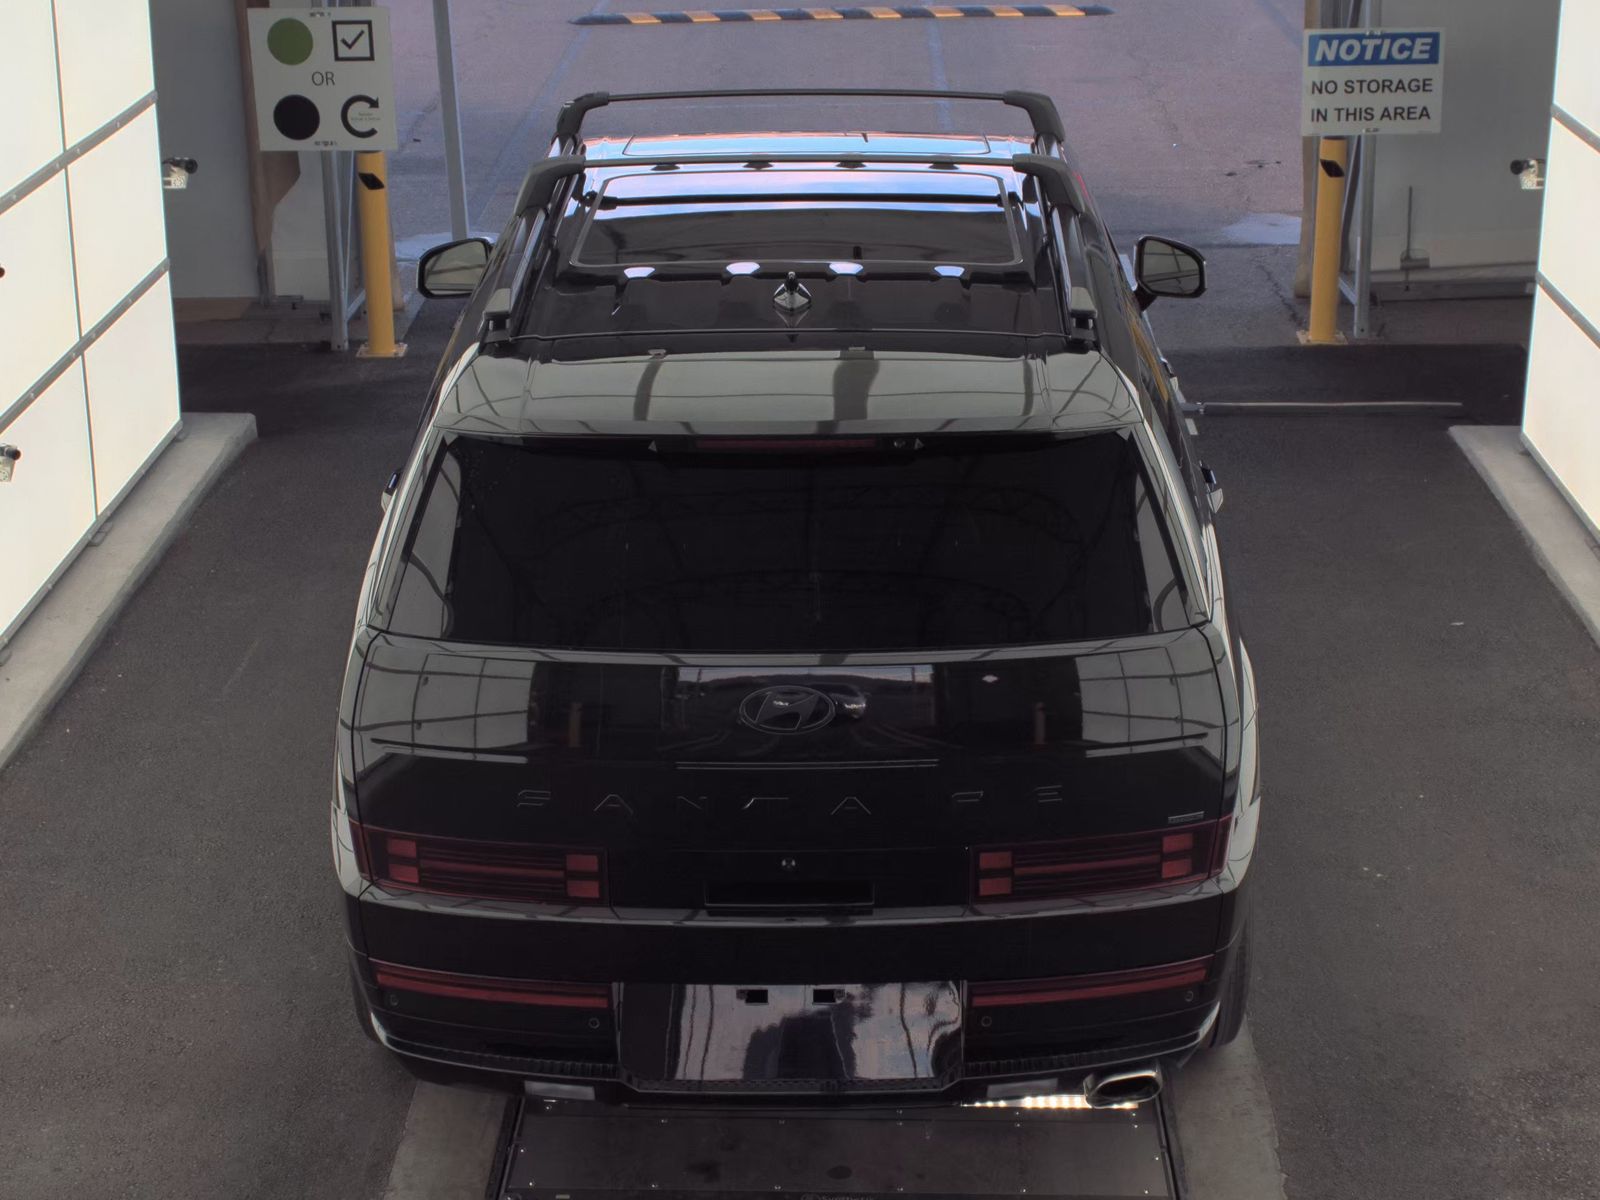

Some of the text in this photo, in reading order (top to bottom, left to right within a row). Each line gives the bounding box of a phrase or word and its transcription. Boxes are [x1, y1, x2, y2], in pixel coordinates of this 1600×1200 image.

[1314, 37, 1433, 62] NOTICE
[311, 71, 336, 86] OR
[1311, 78, 1433, 95] NO STORAGE
[1311, 106, 1431, 122] IN THIS AREA
